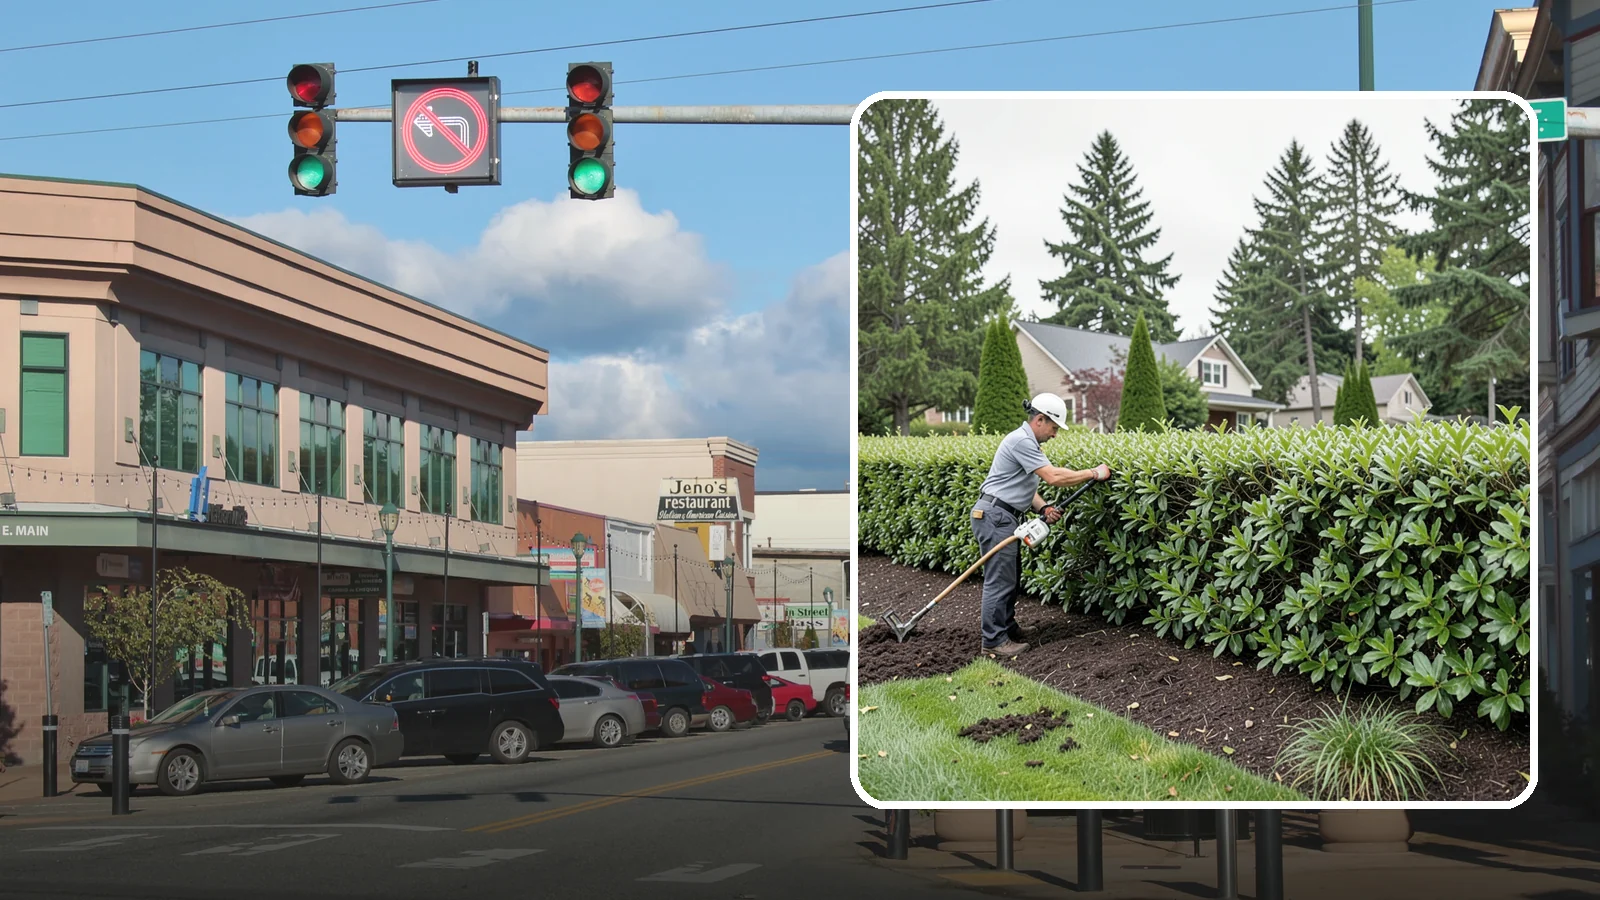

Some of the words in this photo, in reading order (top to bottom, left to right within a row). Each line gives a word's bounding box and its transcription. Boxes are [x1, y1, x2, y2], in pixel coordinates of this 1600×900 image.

[670, 480, 727, 494] Jeno's
[665, 496, 731, 509] restaurant
[658, 510, 681, 519] Italian
[686, 510, 714, 519] American
[715, 509, 737, 519] Cuisine
[2, 525, 13, 536] E.
[15, 525, 49, 536] MAIN
[797, 607, 828, 617] Street
